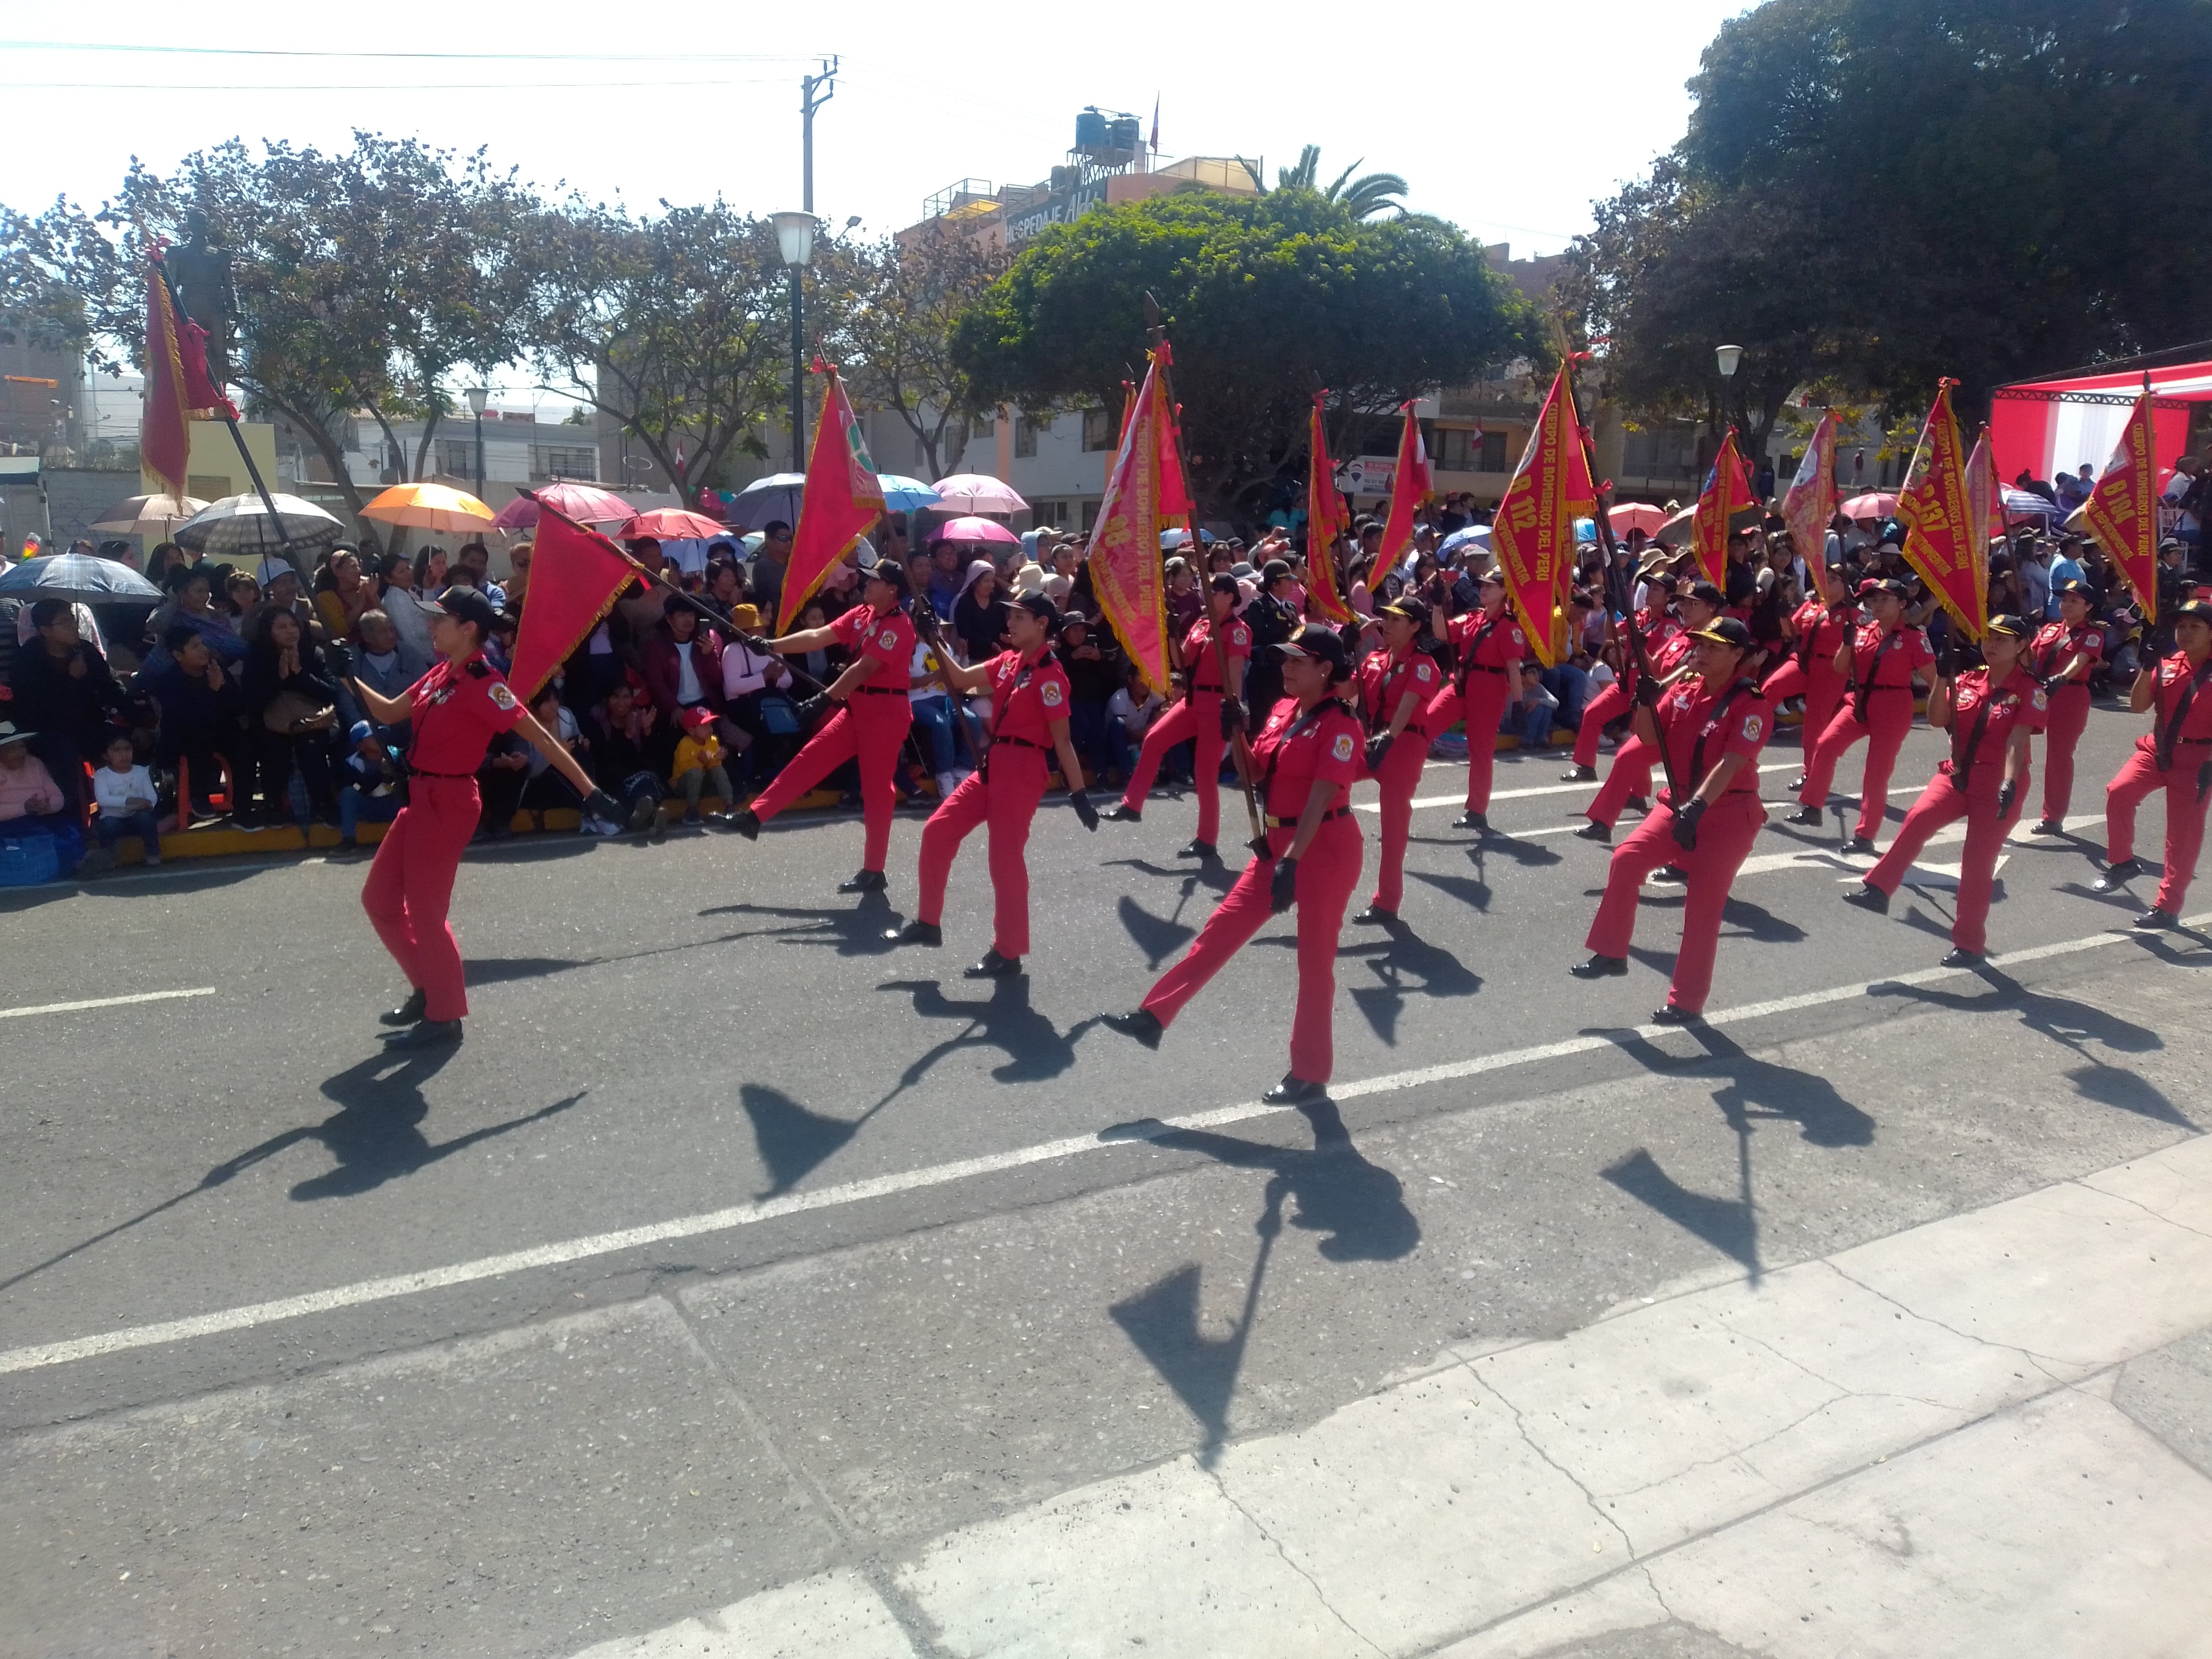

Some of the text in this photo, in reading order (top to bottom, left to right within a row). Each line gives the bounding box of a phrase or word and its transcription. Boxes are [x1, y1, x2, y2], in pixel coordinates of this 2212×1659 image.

[1102, 514, 1131, 547] 98
[1136, 417, 1152, 615] CUERPO DE BOMBEROS DEL PERU
[1510, 496, 1537, 533] 112
[1536, 403, 1559, 581] CUERPO DE BOMBEROS DEL PERU
[1918, 500, 1950, 532] 137
[1937, 418, 1969, 569] CUERPO DE BOMBEROS DEL PERU
[2102, 480, 2127, 496] B
[2133, 423, 2149, 556] CUERPO DE BOMBEROS DEL PERU
